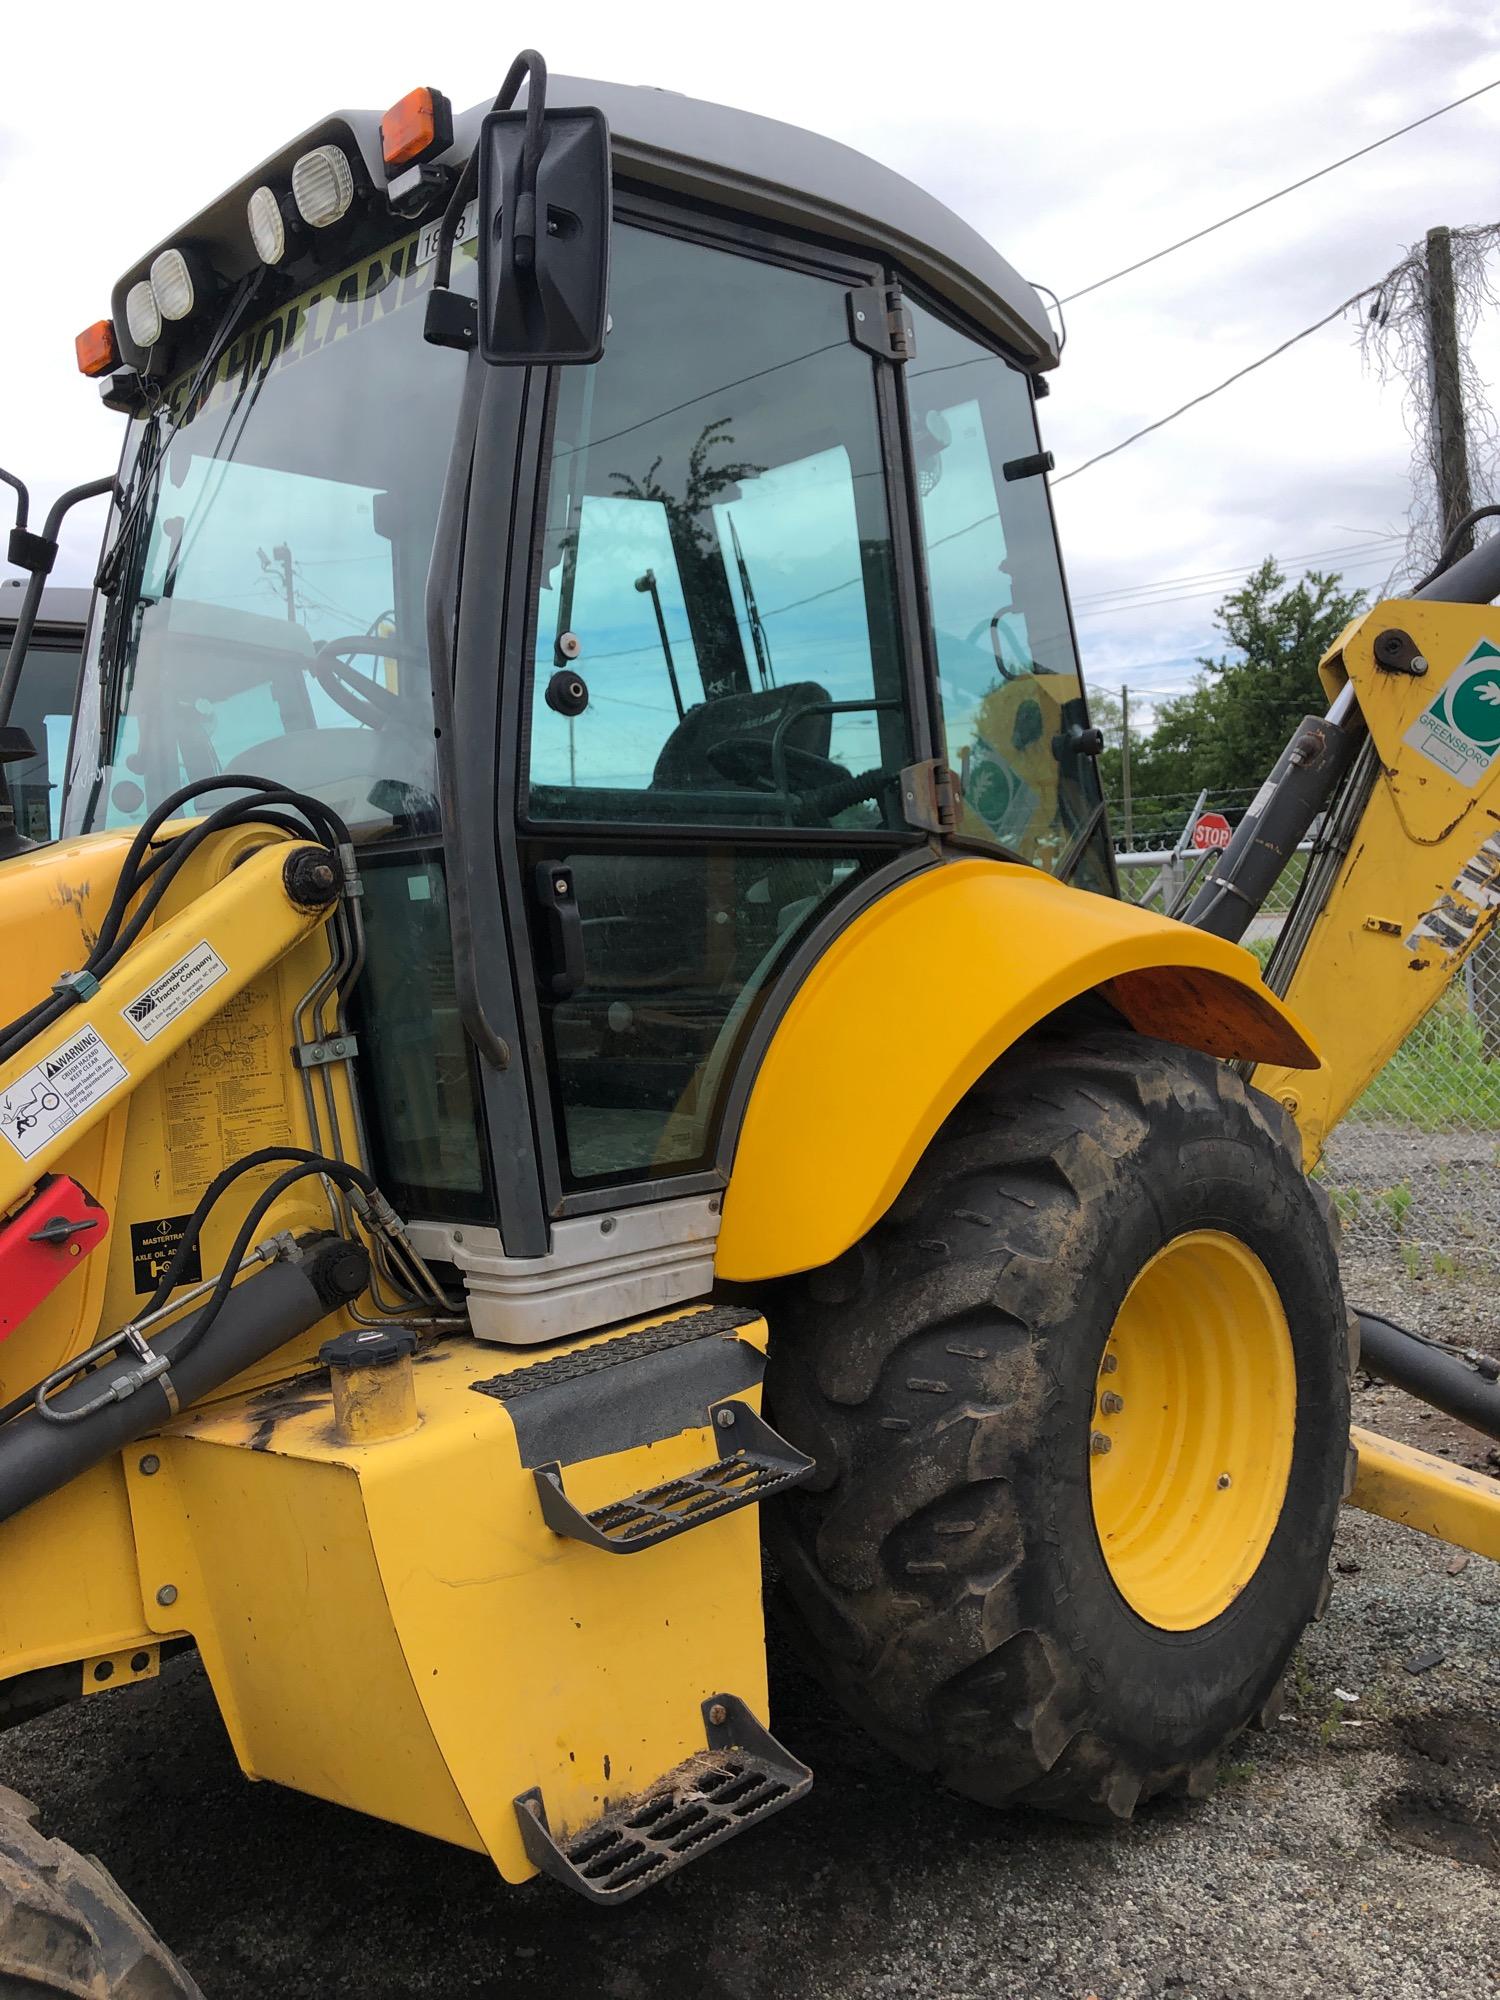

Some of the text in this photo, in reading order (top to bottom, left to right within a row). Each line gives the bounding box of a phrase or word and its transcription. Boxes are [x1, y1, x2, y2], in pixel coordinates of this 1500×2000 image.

[425, 216, 465, 257] 183
[1419, 714, 1489, 768] GREENSBORO
[1195, 825, 1229, 847] STOP
[150, 962, 190, 997] Greensboro
[155, 981, 181, 1004] Tractor
[180, 954, 213, 983] Company
[56, 1033, 97, 1068] WARNING
[61, 1048, 99, 1080] CRUSH HAZARD
[64, 1081, 82, 1098] Support
[80, 1070, 95, 1084] loader
[69, 1057, 98, 1082] KEEP CLEAR
[69, 1065, 113, 1103] during maintenance
[79, 1090, 94, 1103] repair
[142, 1233, 186, 1246] MASTERTRA
[135, 1251, 166, 1262] AXLE OIL
